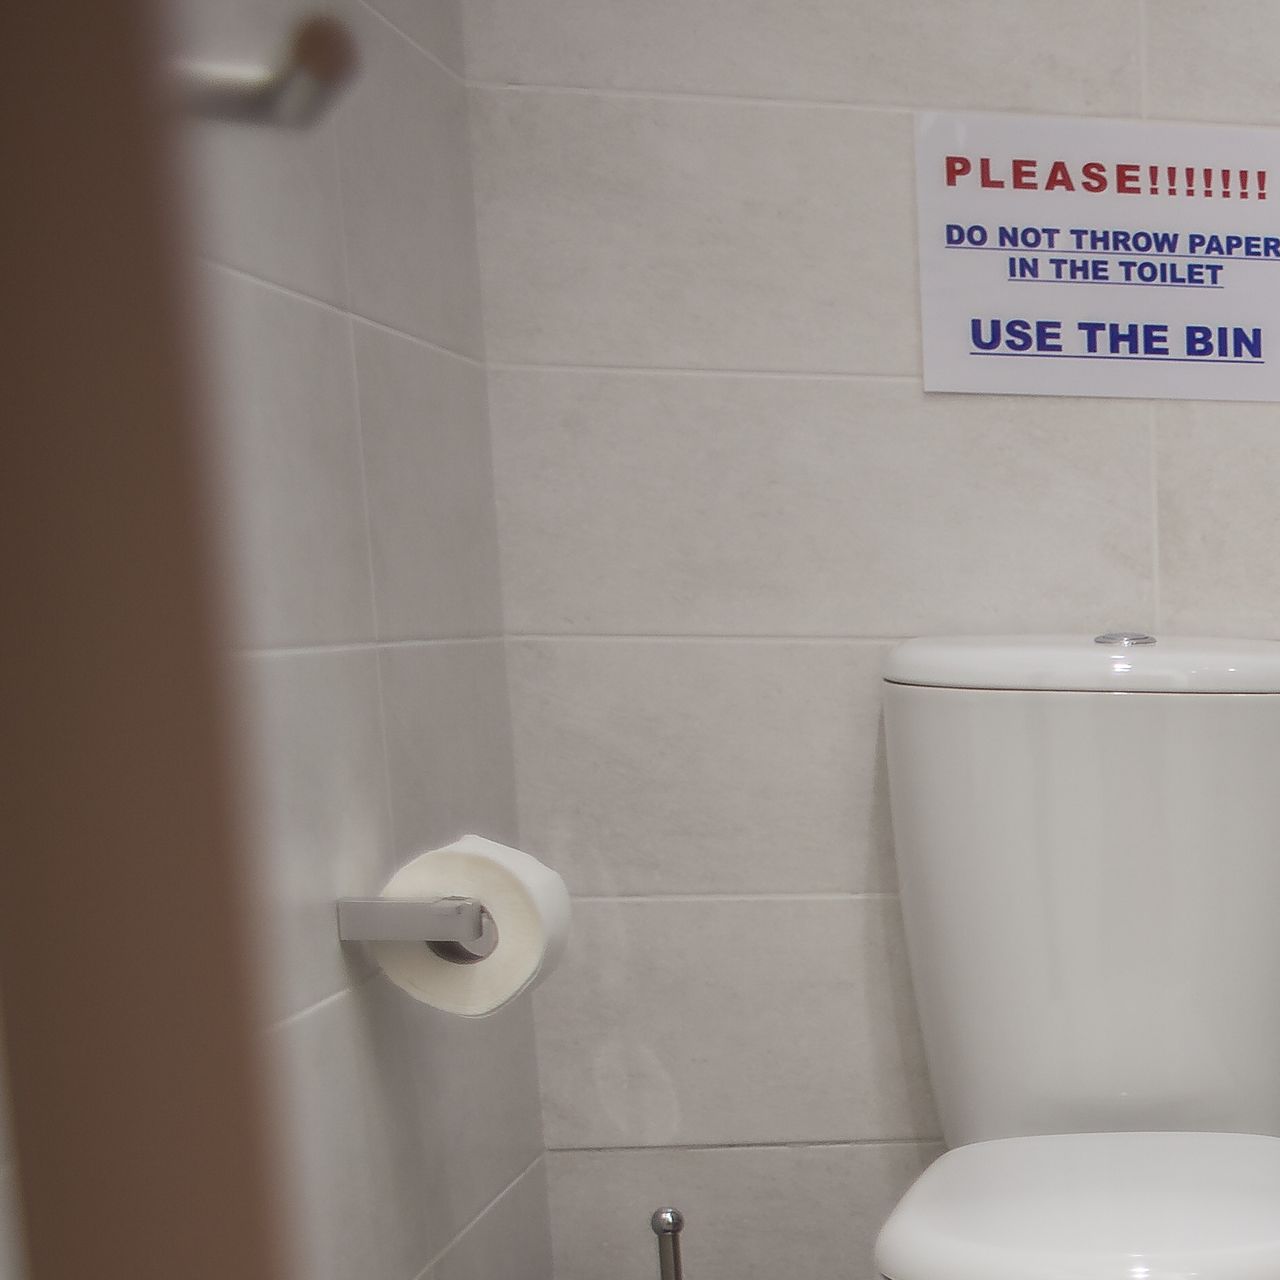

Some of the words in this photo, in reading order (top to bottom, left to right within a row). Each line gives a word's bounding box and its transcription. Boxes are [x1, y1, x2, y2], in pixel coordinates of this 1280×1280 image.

[945, 156, 1267, 200] PLEASE!!!!!!!
[945, 223, 988, 246] DO
[999, 226, 1060, 249] NOT
[1070, 229, 1179, 253] THROW
[1008, 257, 1038, 279] IN
[1050, 258, 1109, 281] THE
[1119, 261, 1223, 285] TOILET
[971, 318, 1062, 353] USE
[1077, 321, 1169, 356] THE
[1185, 325, 1263, 359] BIN
